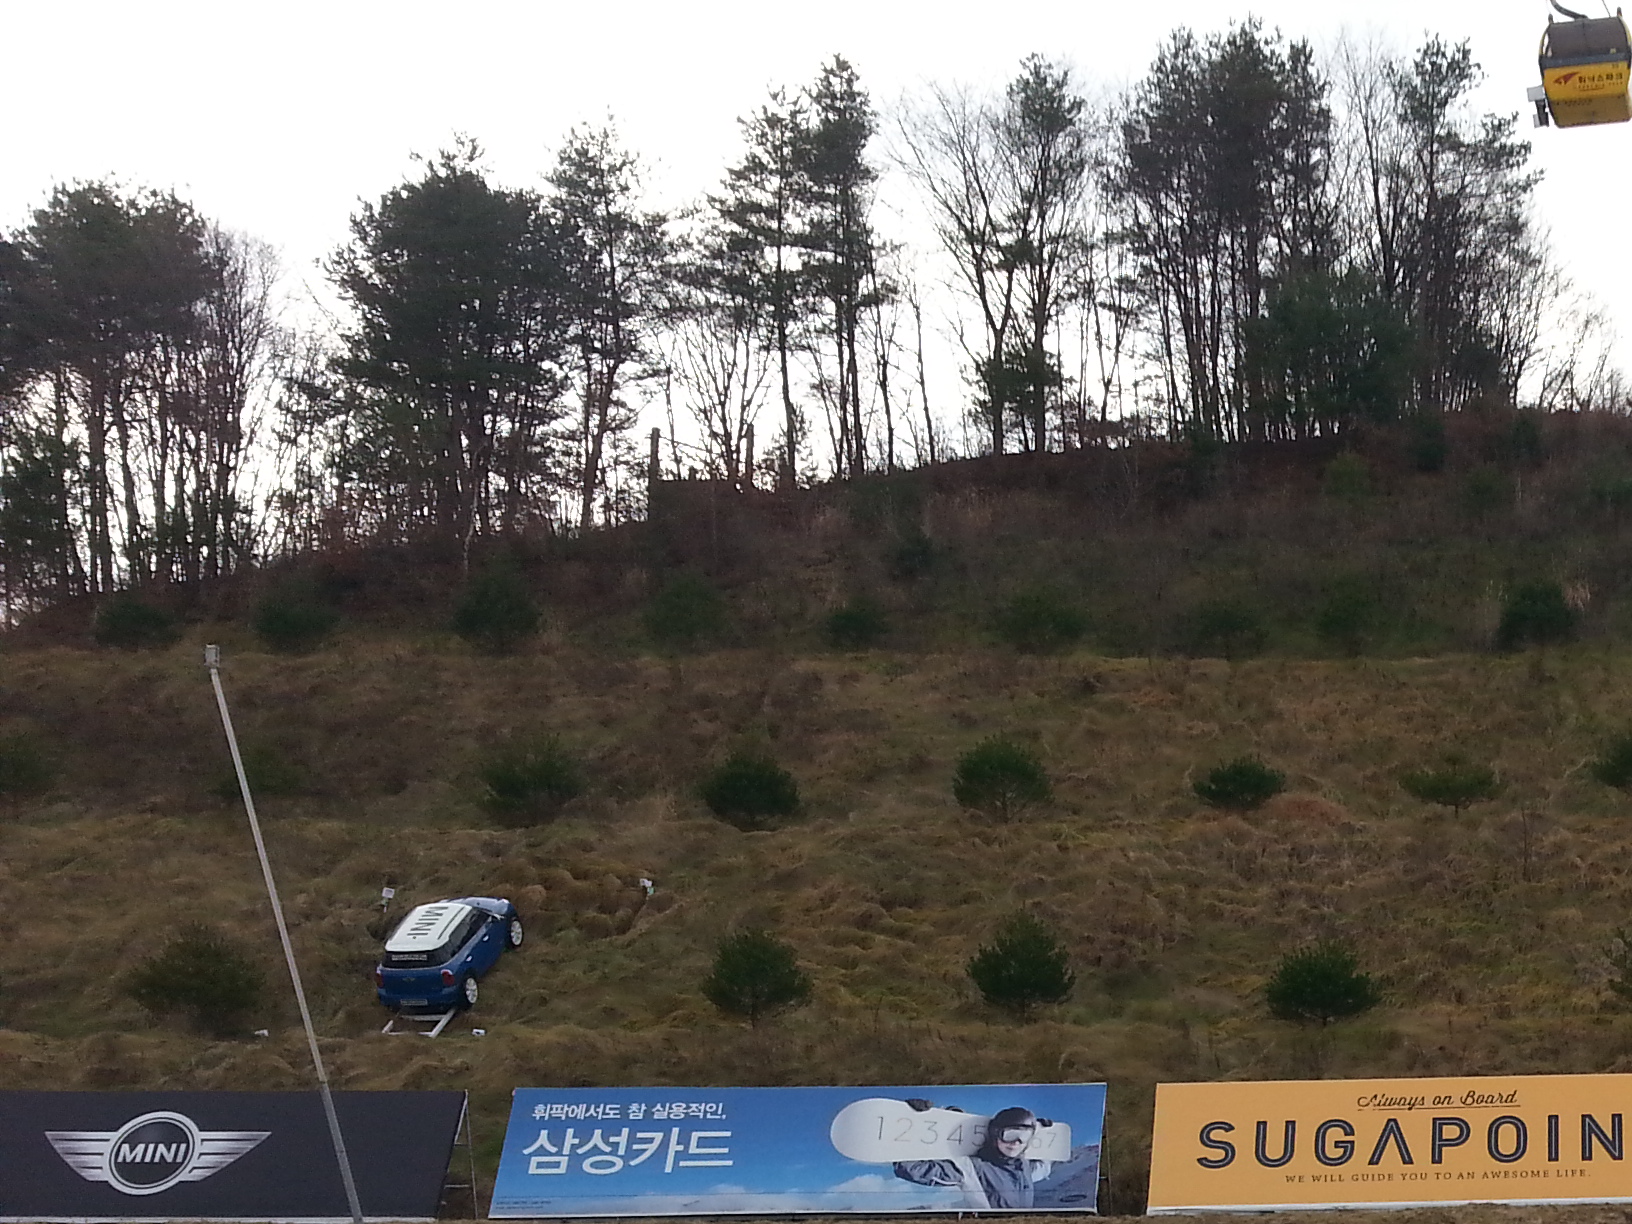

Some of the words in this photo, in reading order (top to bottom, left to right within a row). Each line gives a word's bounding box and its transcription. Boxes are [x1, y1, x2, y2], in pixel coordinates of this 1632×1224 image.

[407, 906, 449, 936] MINI
[1357, 1093, 1426, 1110] Always
[1432, 1095, 1453, 1106] on
[1460, 1090, 1518, 1106] Board
[532, 1103, 621, 1121] 휘팍에서도
[627, 1103, 647, 1120] 참
[117, 1143, 187, 1163] MINI
[522, 1127, 734, 1175] 삼성카드
[1285, 1175, 1305, 1183] WE
[1312, 1174, 1345, 1183] WILL
[1351, 1173, 1395, 1182] GUIDE
[1400, 1172, 1428, 1181] YOU
[1434, 1172, 1451, 1180] TO
[1457, 1171, 1475, 1180] AN
[1482, 1170, 1549, 1179] AWESOME
[1556, 1168, 1591, 1177] LIFE.
